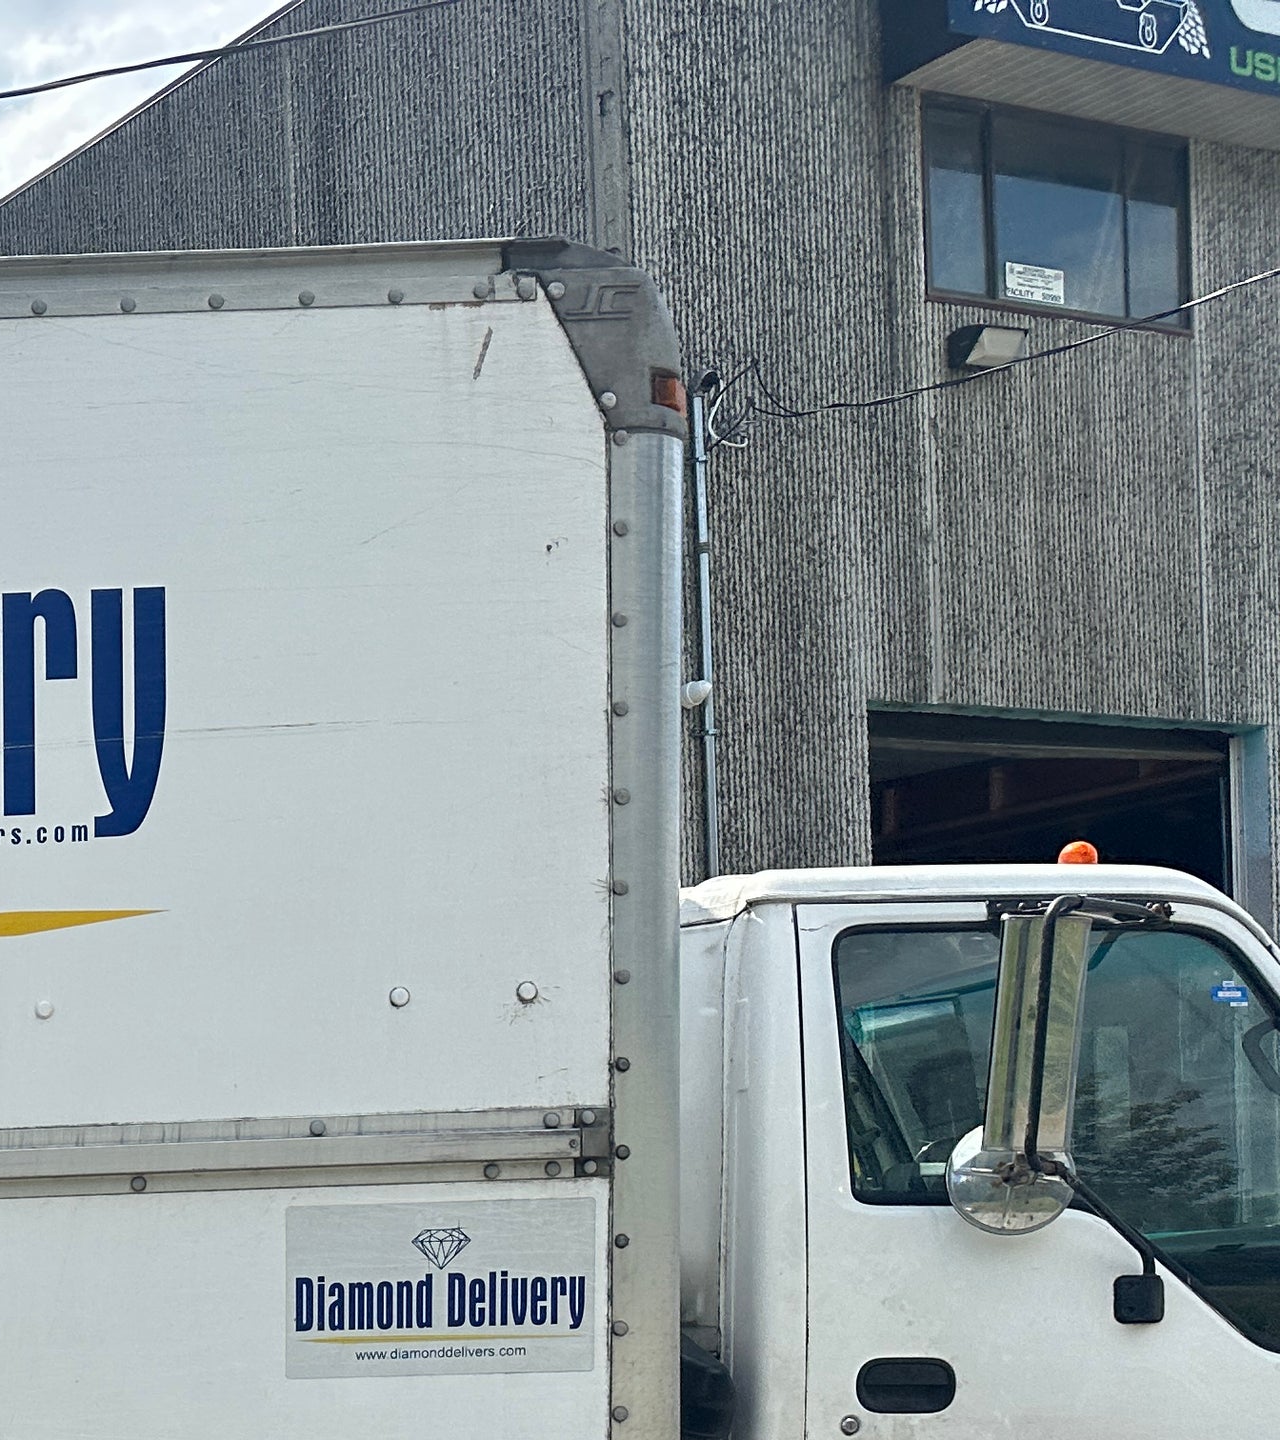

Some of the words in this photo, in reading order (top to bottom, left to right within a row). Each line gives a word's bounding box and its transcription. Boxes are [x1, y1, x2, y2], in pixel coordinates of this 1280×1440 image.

[1230, 46, 1280, 84] US
[295, 1272, 433, 1332] Diamond
[447, 1270, 586, 1329] Delivery
[355, 1345, 527, 1361] www.diamonddelivers.com
